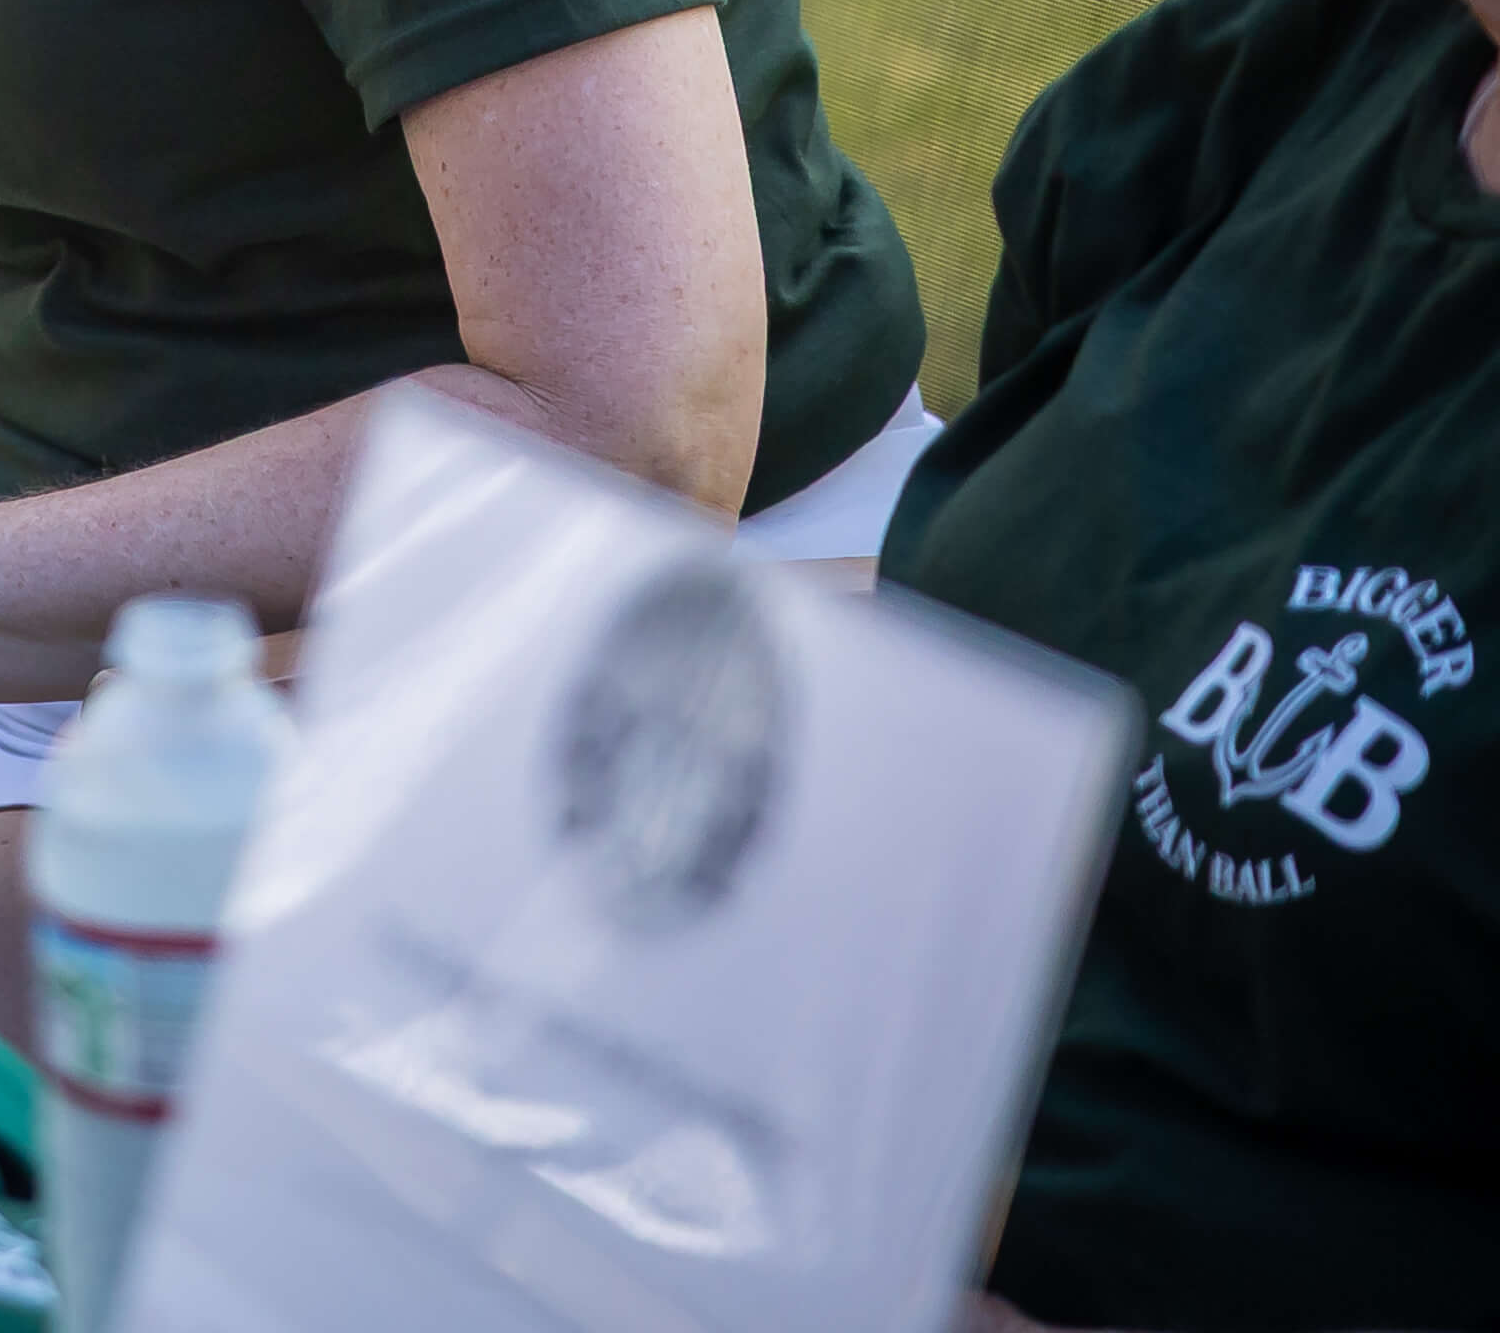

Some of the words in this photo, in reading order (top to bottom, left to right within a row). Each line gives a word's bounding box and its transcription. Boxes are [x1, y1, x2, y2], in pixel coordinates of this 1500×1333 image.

[1286, 564, 1474, 699] BIGGER
[1134, 753, 1207, 882] THAN
[1207, 851, 1317, 906] BALL
